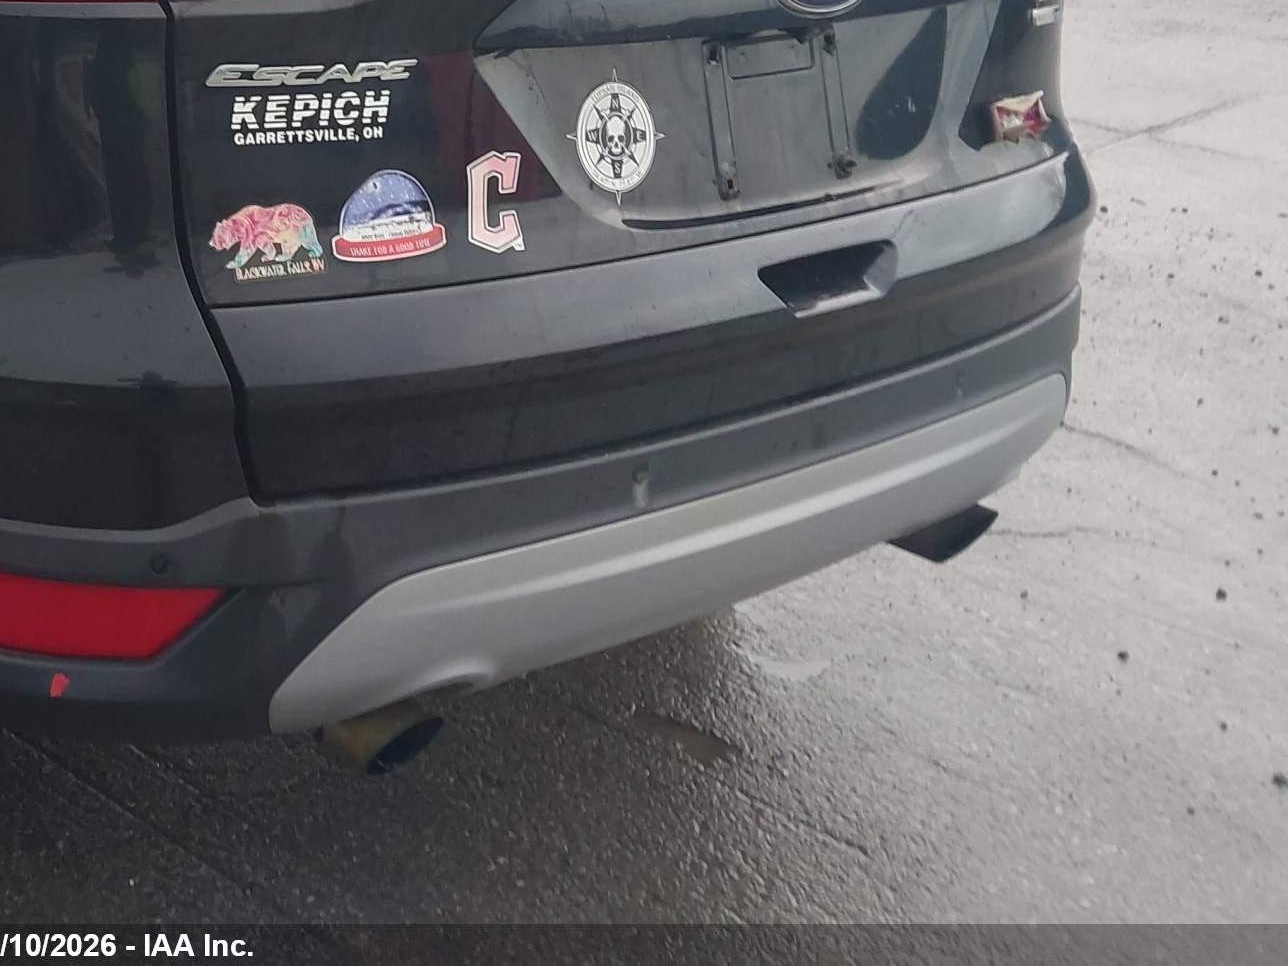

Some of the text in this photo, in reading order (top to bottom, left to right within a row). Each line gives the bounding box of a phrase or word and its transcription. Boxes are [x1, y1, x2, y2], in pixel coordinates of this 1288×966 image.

[205, 59, 418, 87] ESCAPE
[230, 90, 390, 130] KEPICH
[233, 126, 384, 146] GARRETTSVILLE, OH
[466, 150, 522, 253] C
